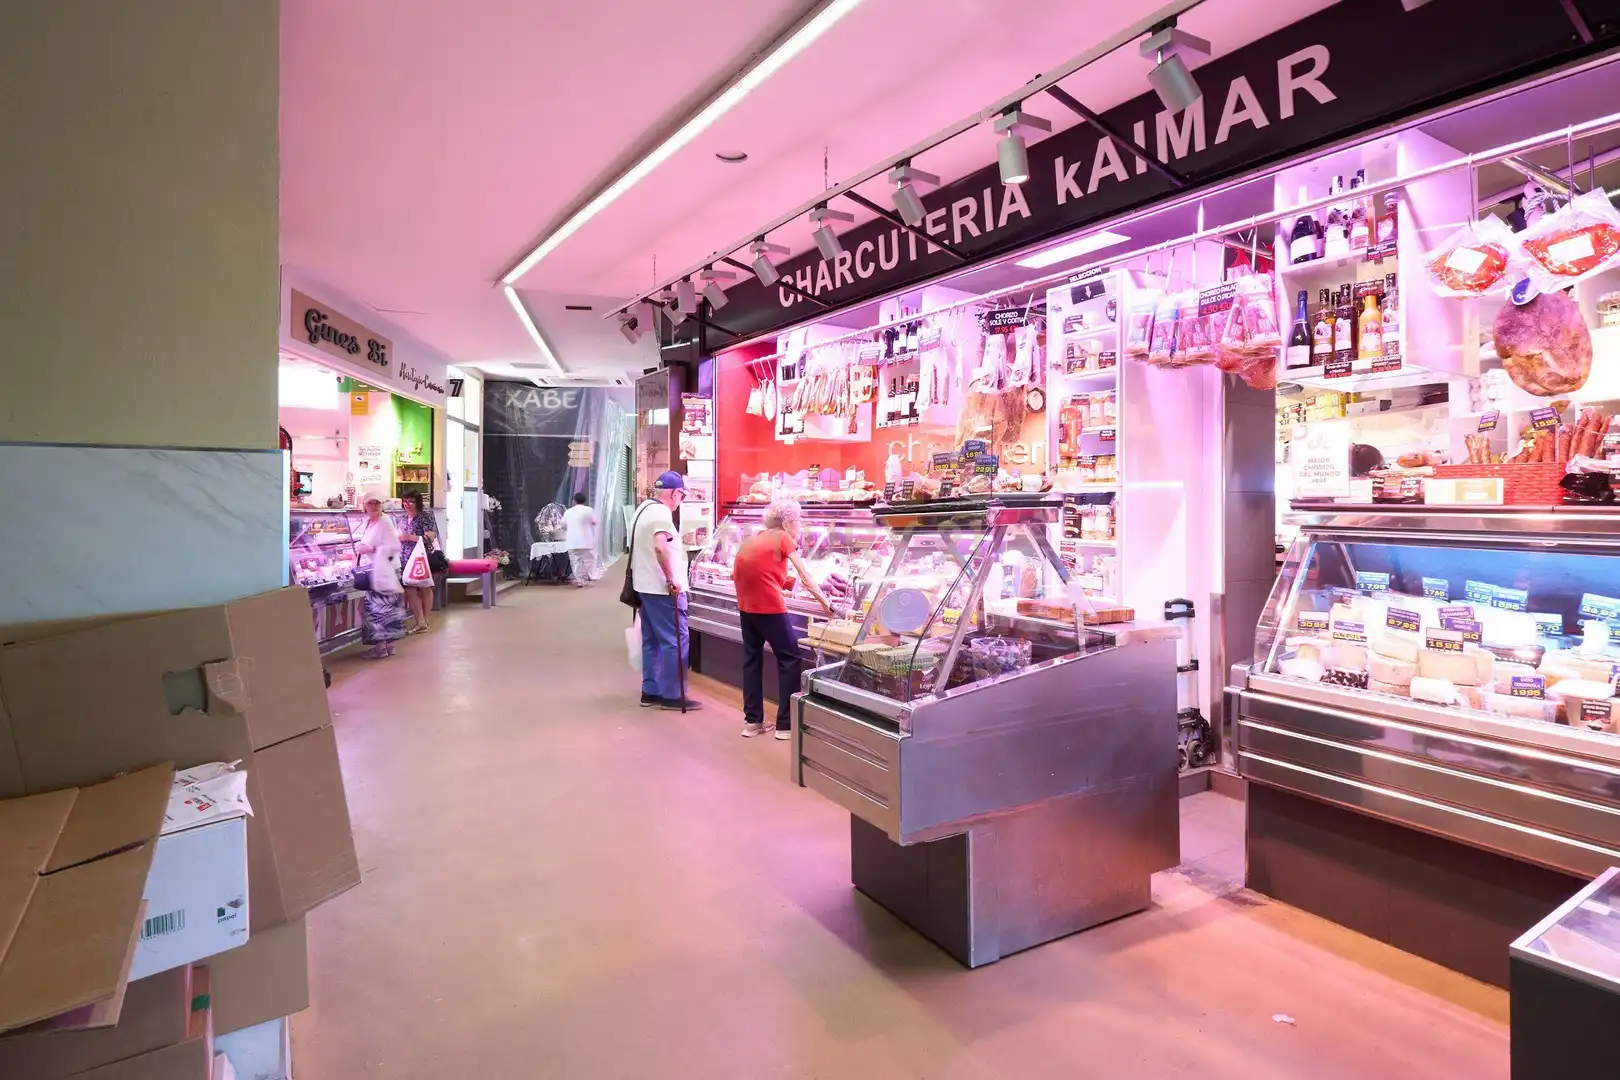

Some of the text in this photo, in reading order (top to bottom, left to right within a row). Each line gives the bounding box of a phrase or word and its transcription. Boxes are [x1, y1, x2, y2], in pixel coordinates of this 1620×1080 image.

[779, 182, 1032, 308] CHARCUTERIA
[995, 311, 1018, 320] CHORIZO
[449, 378, 465, 397] 7
[504, 388, 579, 410] XABE
[1314, 470, 1342, 478] MUNDO
[217, 912, 238, 924] papel
